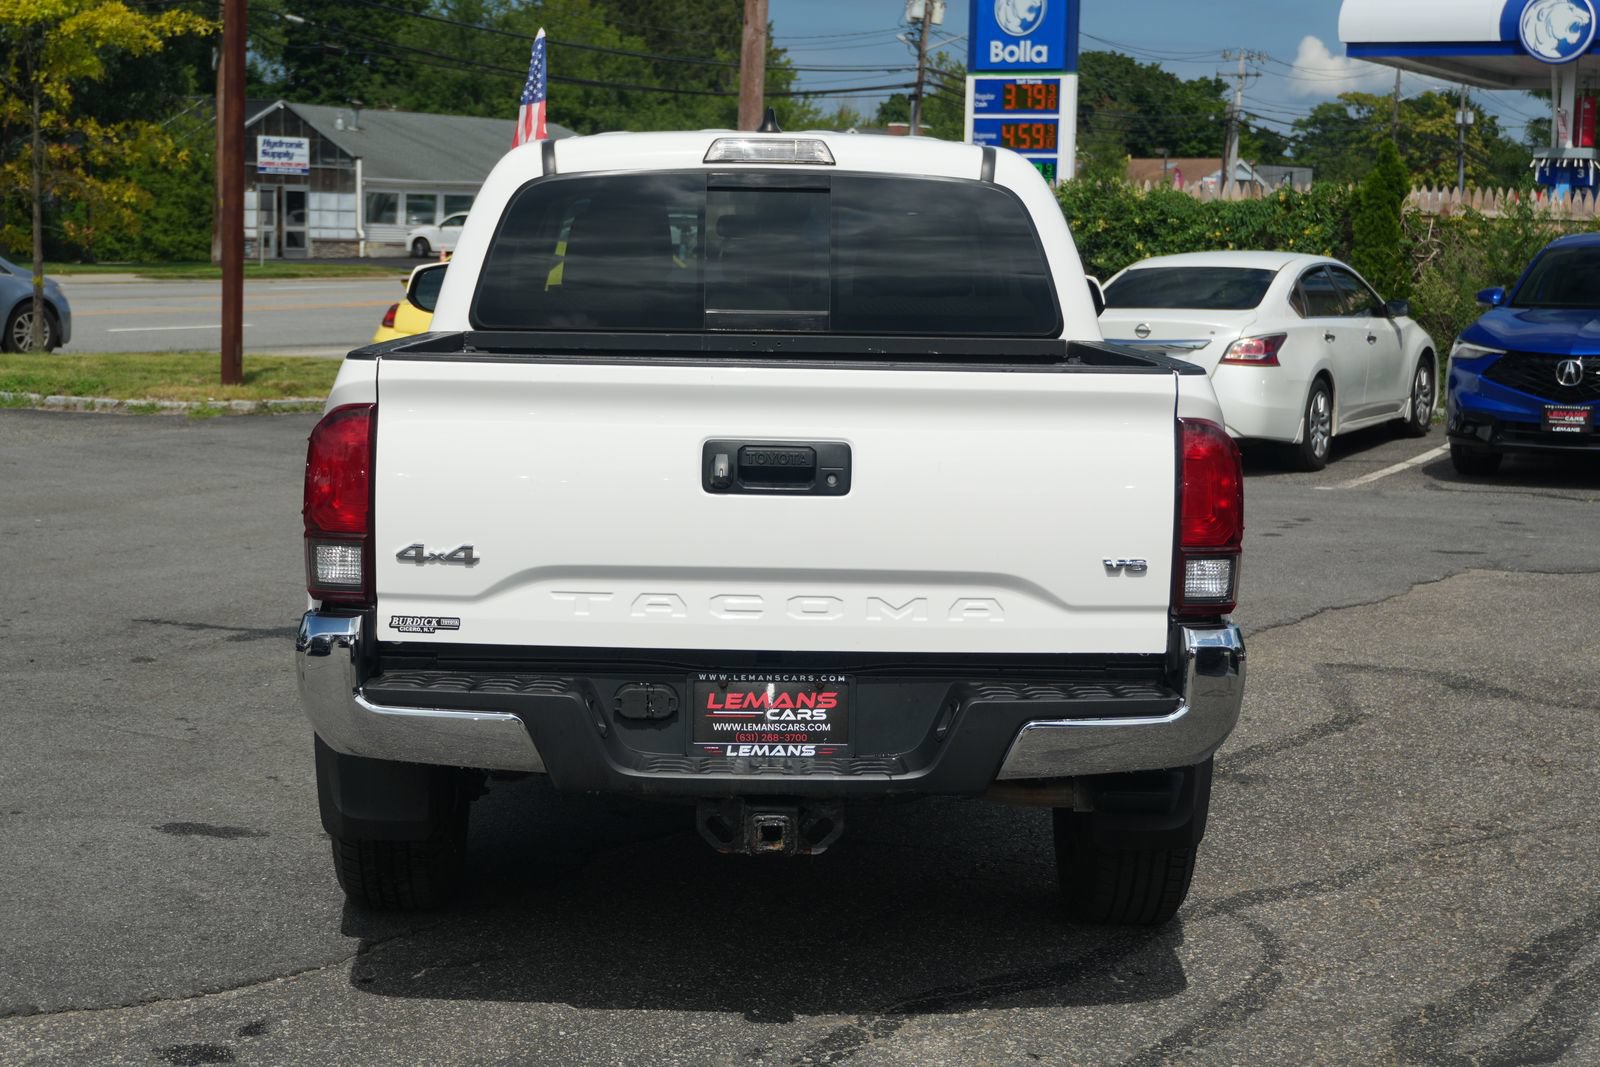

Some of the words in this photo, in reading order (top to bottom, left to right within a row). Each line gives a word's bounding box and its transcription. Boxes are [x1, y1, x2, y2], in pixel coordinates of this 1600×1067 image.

[989, 40, 1048, 63] Bolla
[262, 139, 305, 150] Hydronic
[262, 149, 294, 160] Supply
[745, 451, 811, 465] TOYOTA
[1102, 558, 1148, 577] V6
[550, 590, 1005, 623] TACOMA
[391, 616, 439, 627] BURDICK
[699, 673, 846, 682] WWW.LEMANSCARS.COM
[706, 691, 838, 709] LEMANS
[766, 708, 827, 721] CARS
[712, 722, 831, 732] WWW.LEMANSCARS.COM
[735, 732, 759, 743] (631)
[726, 745, 816, 757] LEMANS
